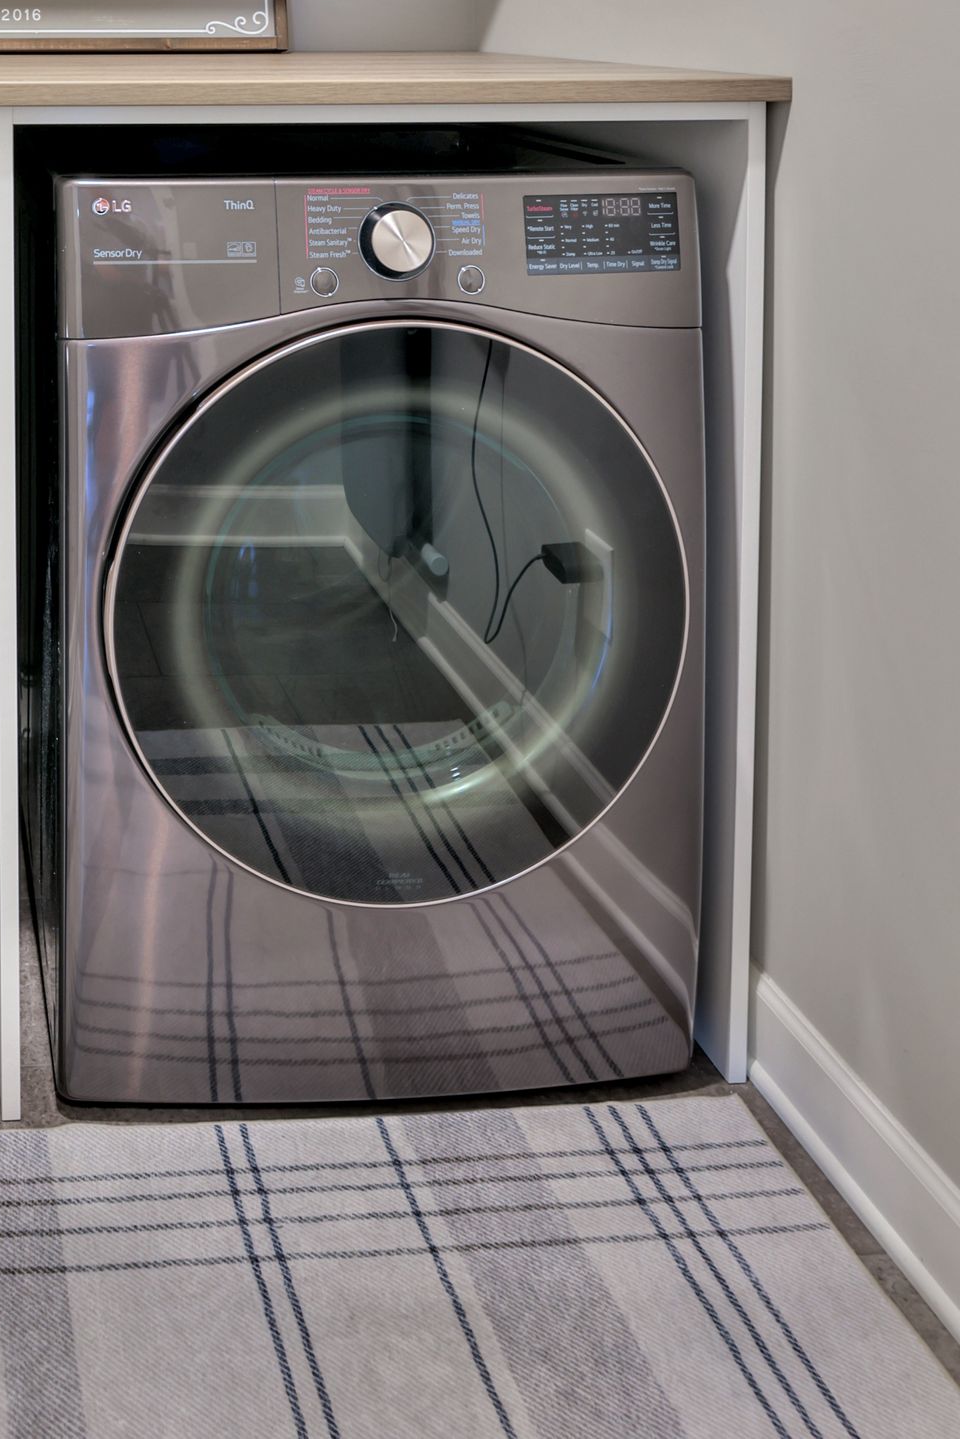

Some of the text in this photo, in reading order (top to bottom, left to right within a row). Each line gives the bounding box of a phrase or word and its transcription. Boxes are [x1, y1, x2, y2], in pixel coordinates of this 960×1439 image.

[1, 9, 42, 22] 2016
[112, 200, 132, 212] LG
[224, 200, 255, 210] ThinQ
[327, 205, 341, 213] Duty
[308, 217, 332, 225] Bedding
[452, 226, 480, 234] Speed Dry
[471, 237, 481, 245] Dry
